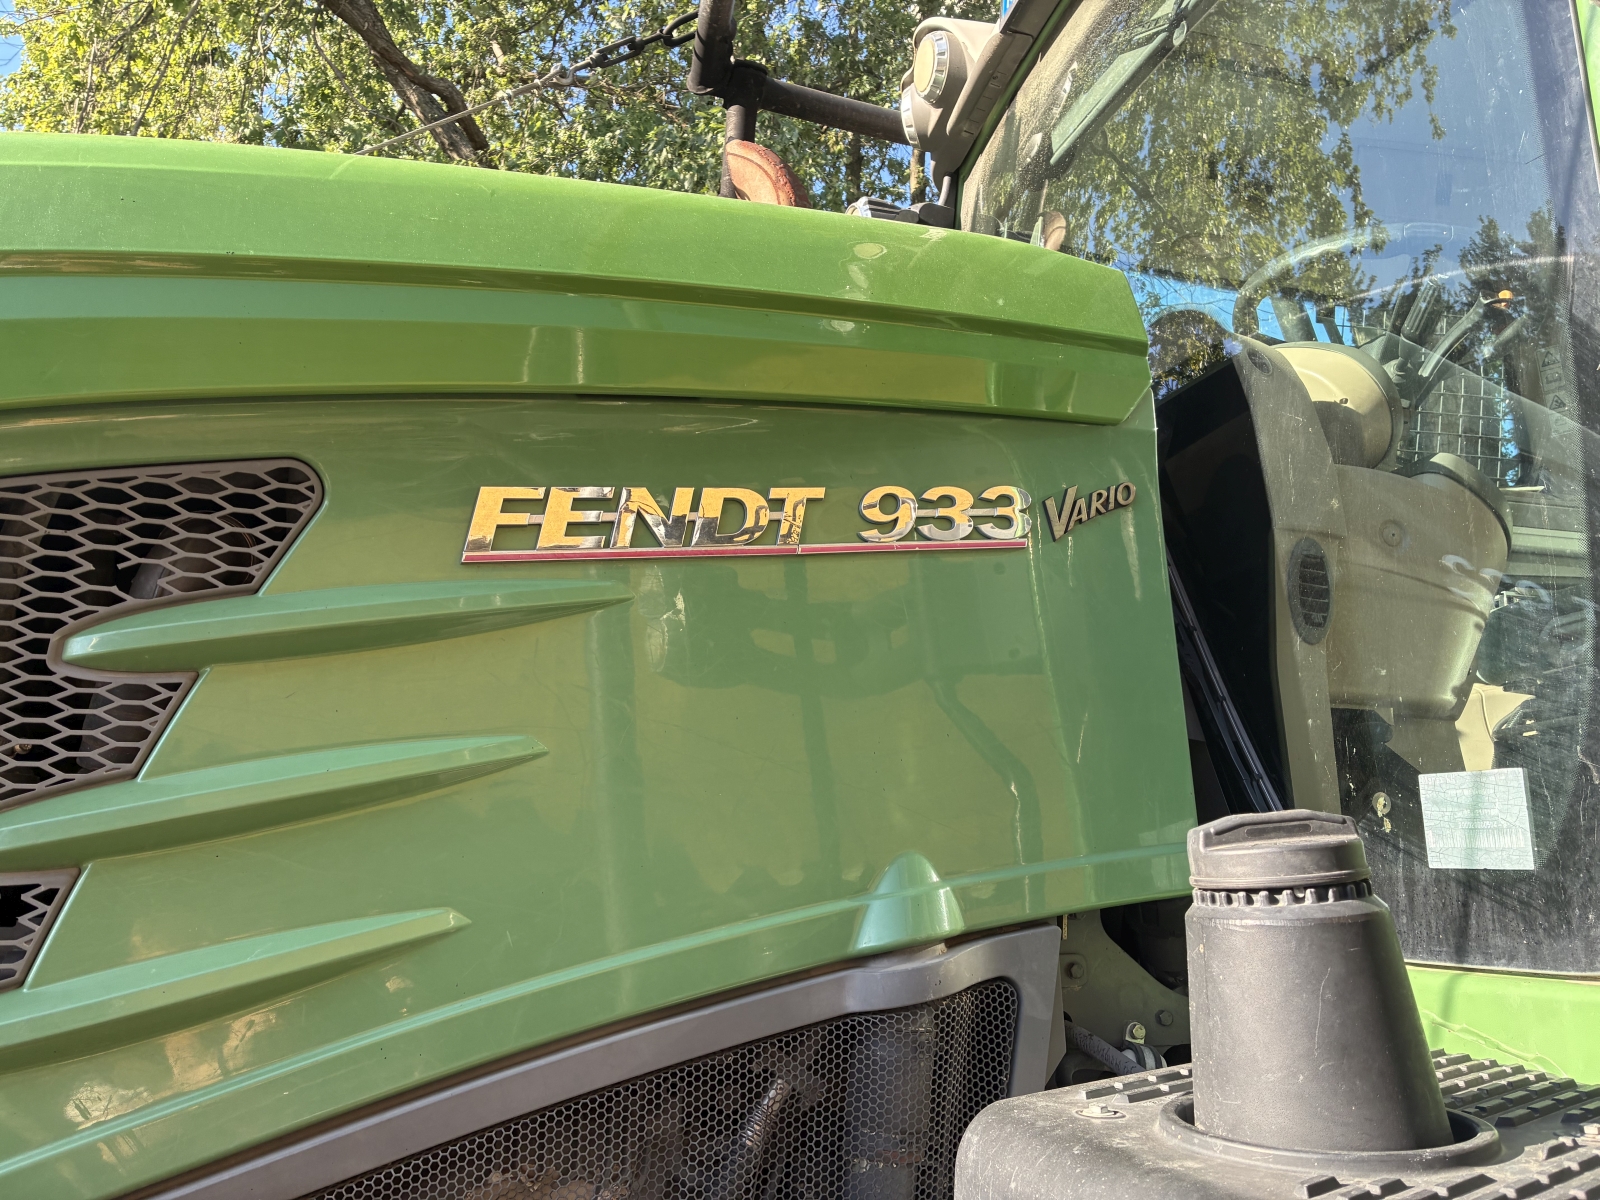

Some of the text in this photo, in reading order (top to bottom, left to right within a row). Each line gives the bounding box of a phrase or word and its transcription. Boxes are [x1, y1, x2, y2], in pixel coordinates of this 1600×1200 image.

[464, 482, 1137, 551] FENDT 933 VARIO
